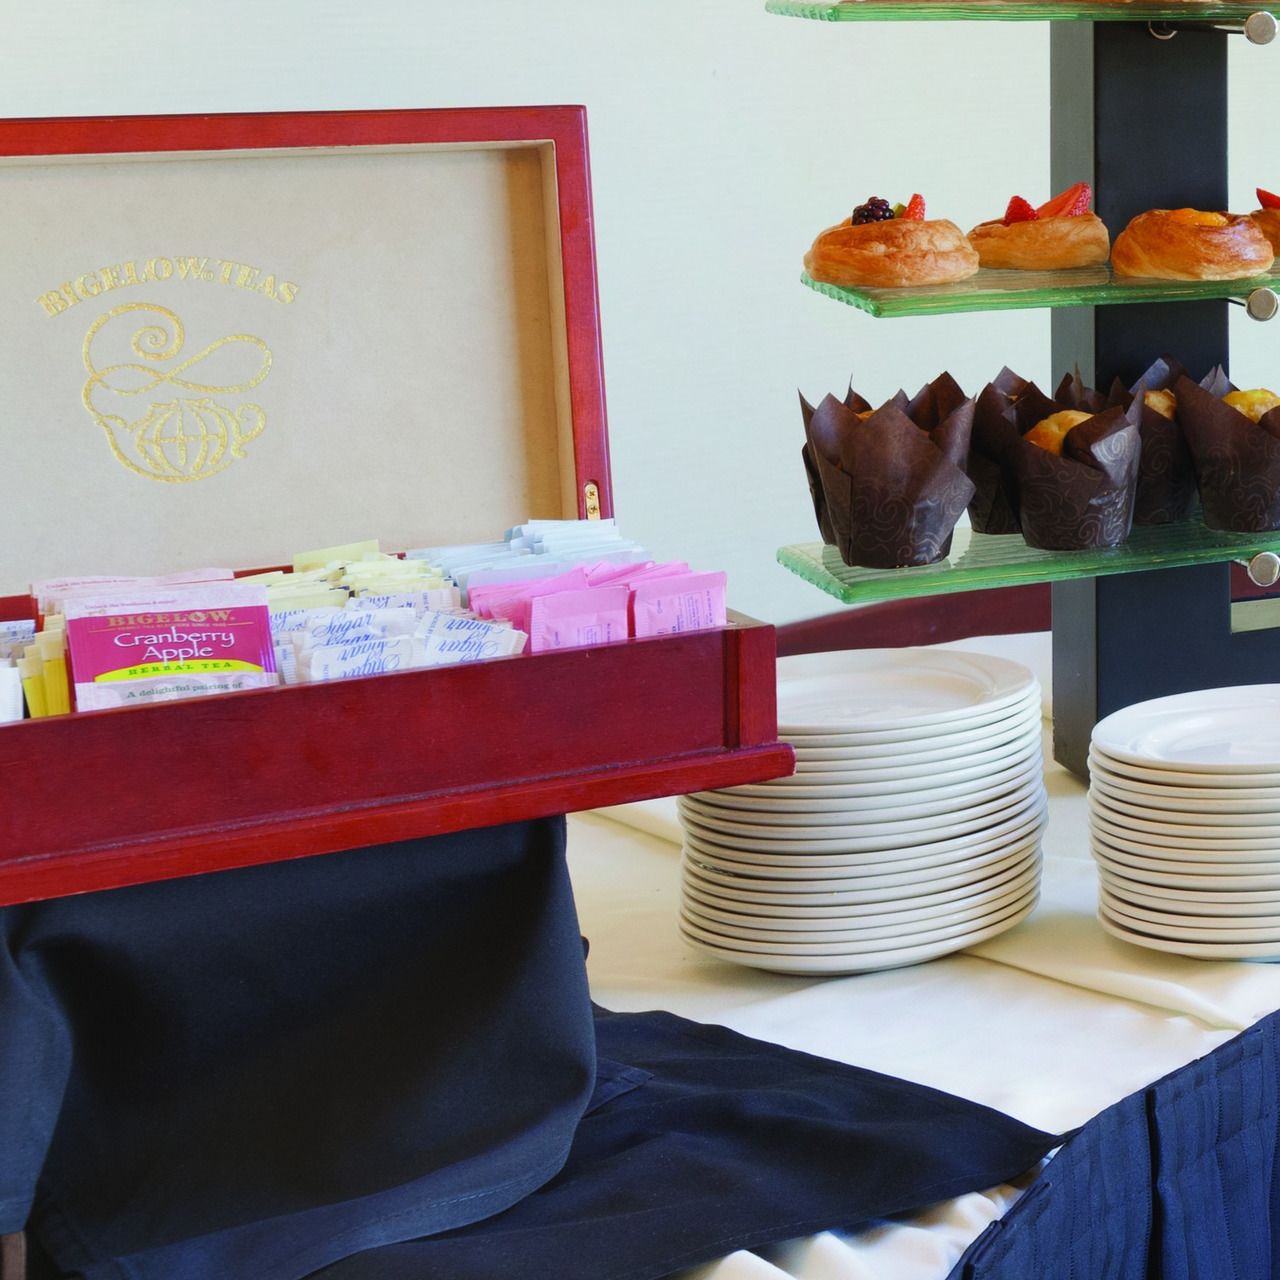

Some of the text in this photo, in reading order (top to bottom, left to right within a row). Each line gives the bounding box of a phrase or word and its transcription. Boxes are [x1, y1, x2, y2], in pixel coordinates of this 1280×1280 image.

[35, 256, 300, 317] BIGELOW TEAS
[109, 610, 233, 627] BIGELOW
[312, 612, 374, 638] Sugar
[113, 626, 236, 648] Cranberry
[142, 640, 215, 666] Apple
[127, 664, 195, 676] HERBAL
[127, 681, 244, 699] A delightful pairing of
